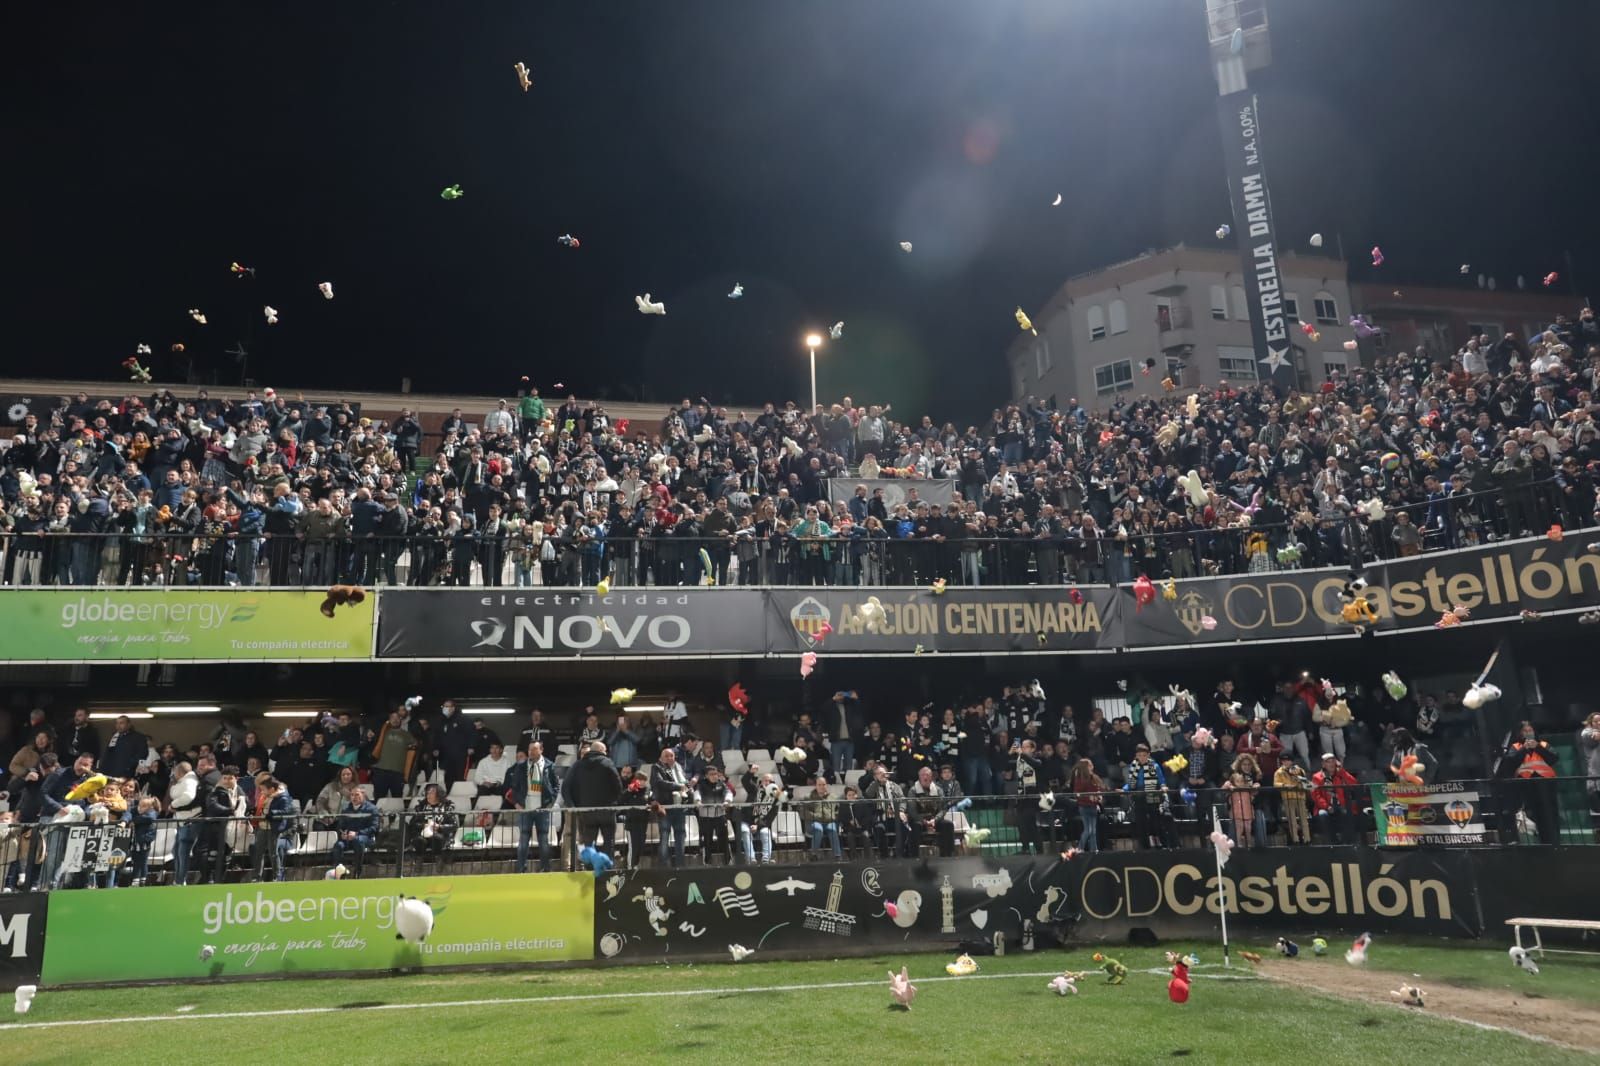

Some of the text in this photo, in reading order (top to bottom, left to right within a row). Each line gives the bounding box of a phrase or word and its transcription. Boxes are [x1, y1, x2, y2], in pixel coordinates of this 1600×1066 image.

[1242, 173, 1270, 238] DAMM
[1253, 242, 1286, 342] ESTRELLA
[61, 597, 229, 629] globeenergy
[481, 594, 688, 606] electricidad
[513, 615, 691, 649] NOVO
[945, 602, 1101, 635] CENTENARIA
[231, 640, 243, 649] Tu
[70, 827, 132, 839] CALAVERA
[203, 892, 400, 934] globeenerg
[224, 926, 368, 967] energía para todos
[417, 941, 433, 954] Tu
